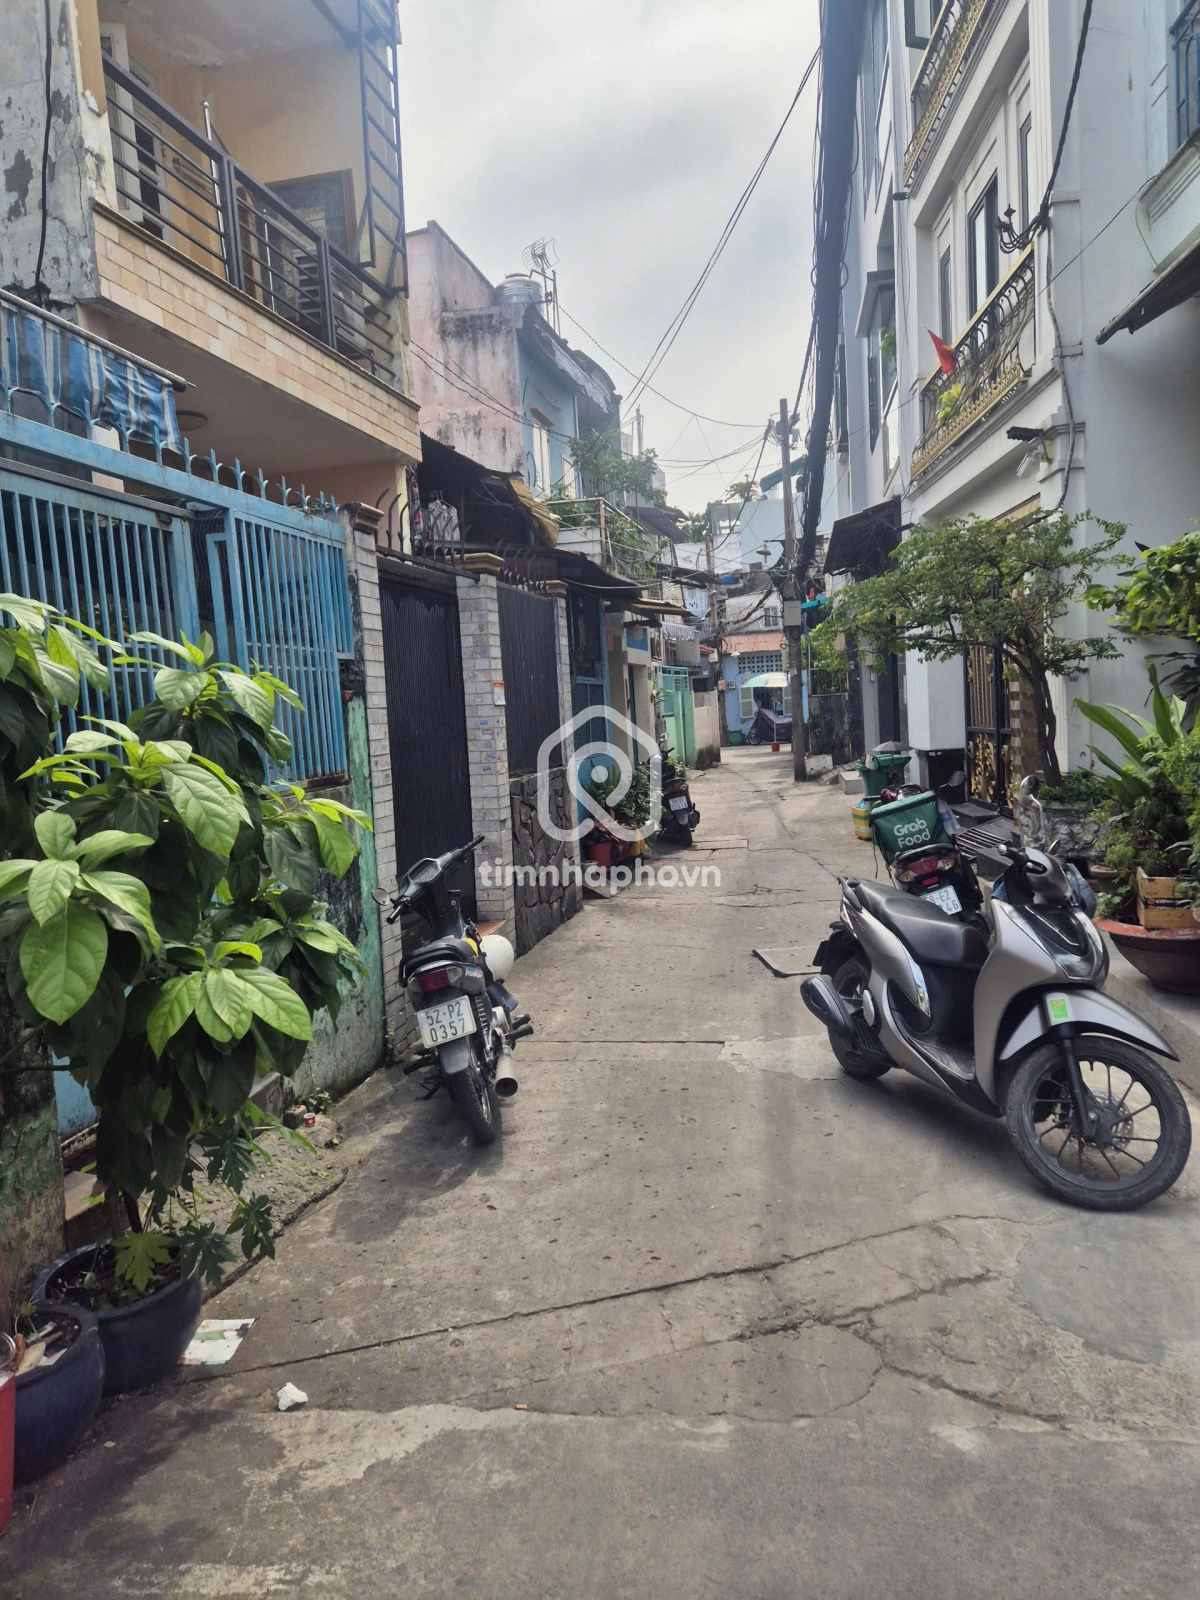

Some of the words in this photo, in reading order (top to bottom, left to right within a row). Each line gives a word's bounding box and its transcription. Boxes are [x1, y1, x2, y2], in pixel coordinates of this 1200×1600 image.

[893, 818, 927, 836] Grab
[897, 828, 931, 848] Food
[425, 1001, 464, 1026] 52-P2
[429, 1017, 465, 1043] 0357
